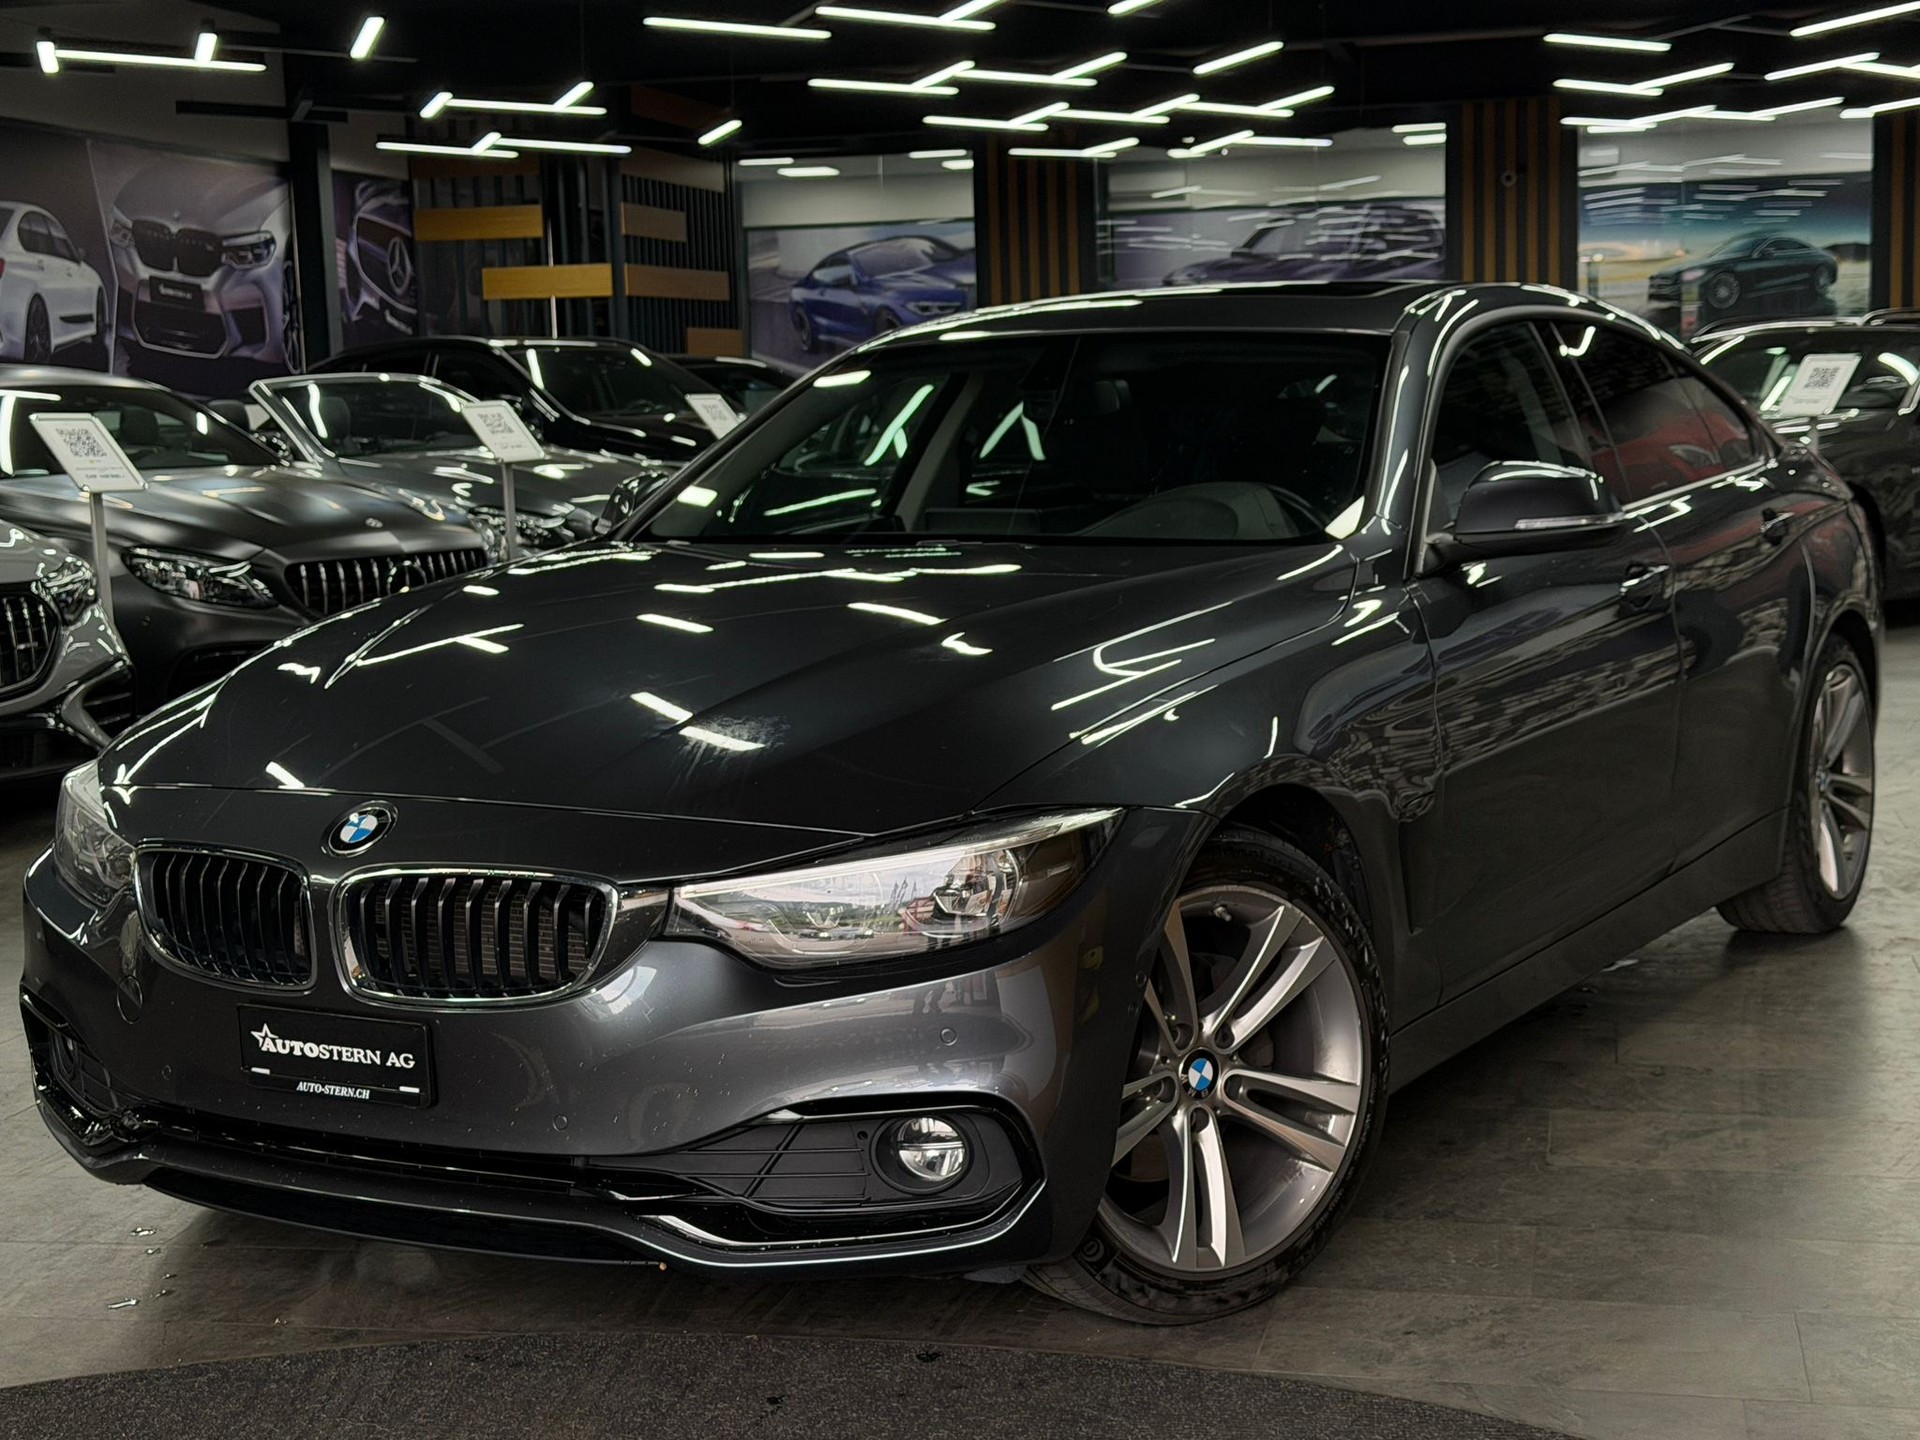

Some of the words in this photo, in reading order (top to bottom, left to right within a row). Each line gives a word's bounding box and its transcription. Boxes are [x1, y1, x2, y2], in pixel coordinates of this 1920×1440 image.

[261, 1037, 382, 1065] AUTOSTERN
[386, 1052, 415, 1068] AG
[296, 1081, 370, 1100] AUTO-STERN.CH
